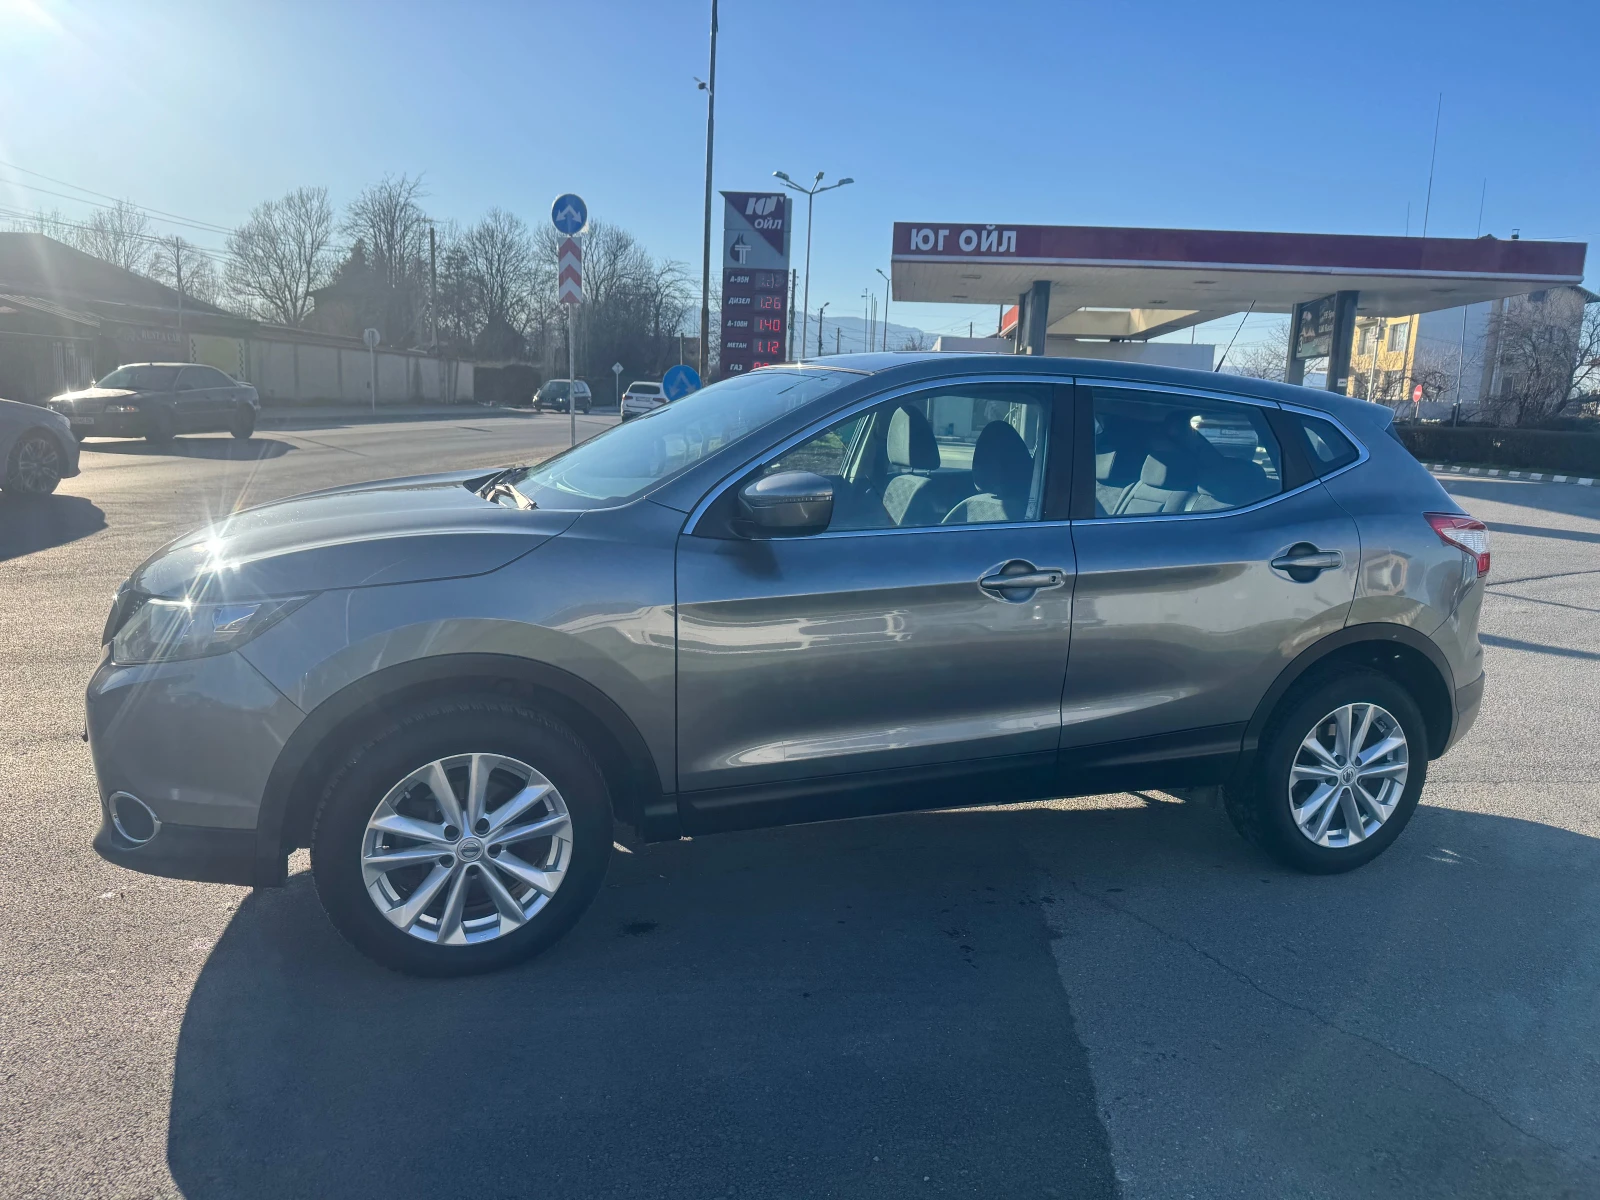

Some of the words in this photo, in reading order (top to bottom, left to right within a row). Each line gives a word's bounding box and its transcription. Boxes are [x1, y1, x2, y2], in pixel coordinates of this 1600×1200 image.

[754, 217, 782, 230] ОЙЛ
[910, 228, 950, 251] ЮГ
[958, 224, 1017, 253] ОЙЛ
[728, 297, 751, 305] ДИЗЕЛ
[759, 319, 781, 331] 1.40
[729, 363, 743, 371] ГАЗ
